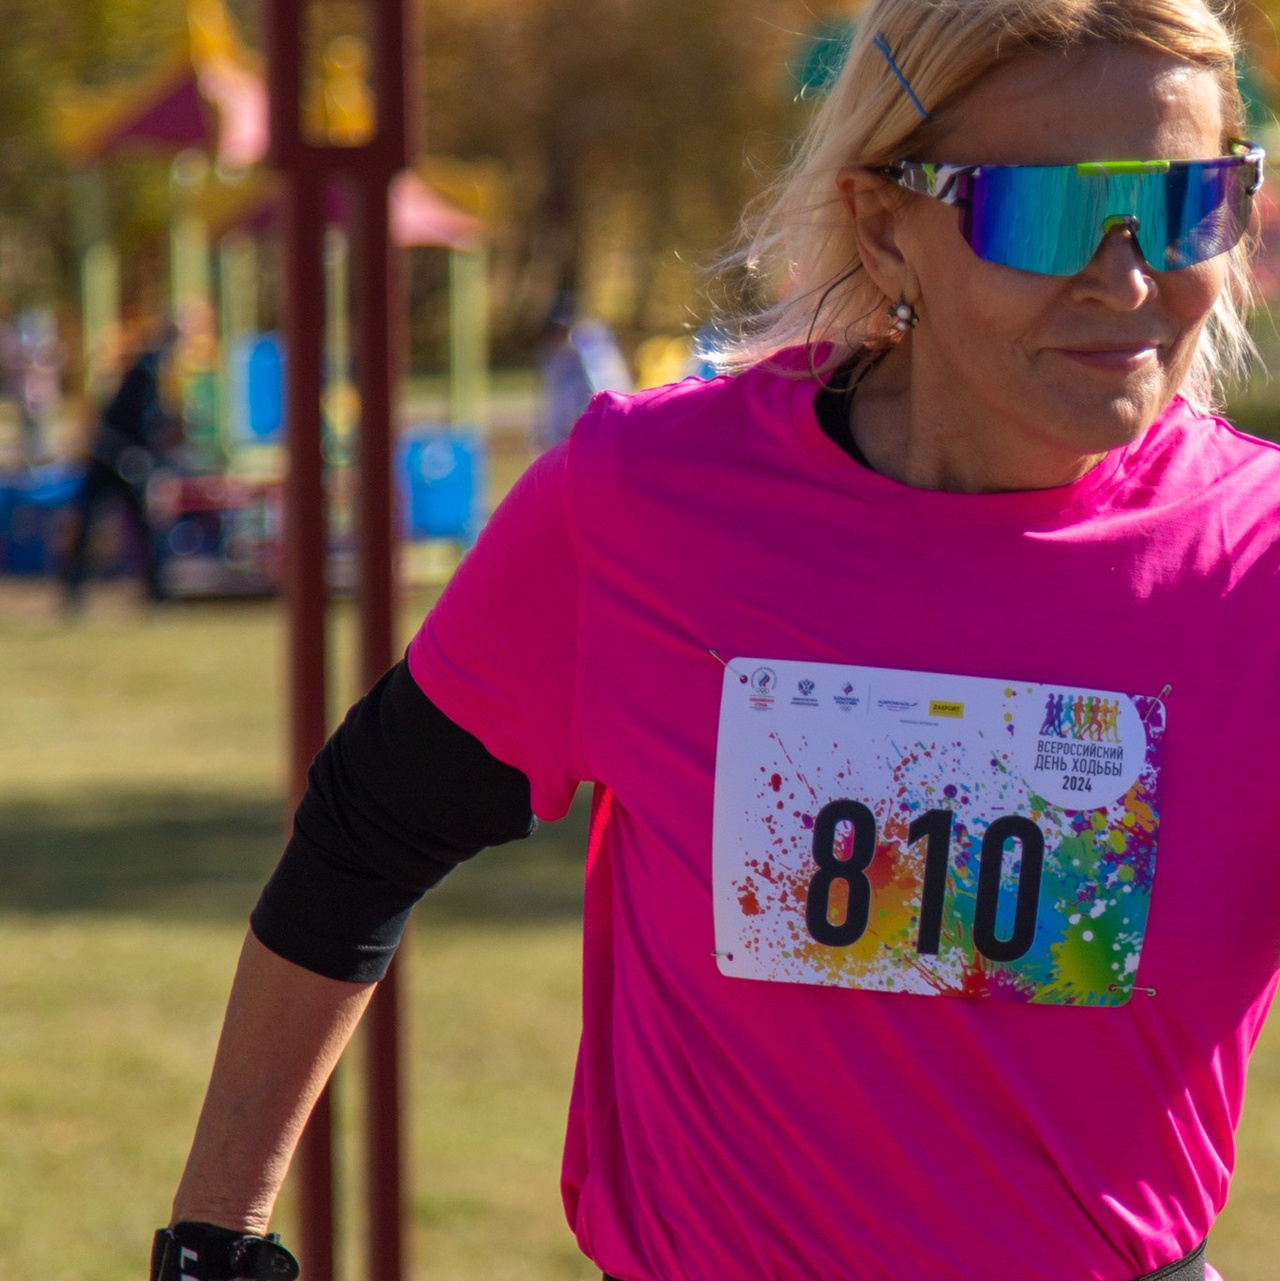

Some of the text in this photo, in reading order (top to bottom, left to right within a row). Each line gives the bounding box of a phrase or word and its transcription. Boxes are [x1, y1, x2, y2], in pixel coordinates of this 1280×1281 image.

[932, 704, 961, 712] ZASPORT
[1037, 740, 1124, 761] ВСЕРОССИЙСКИЙ
[1034, 754, 1123, 777] ДЕНЬ ХОДЬБЫ
[1062, 775, 1093, 793] 2024
[805, 799, 1045, 963] 810
